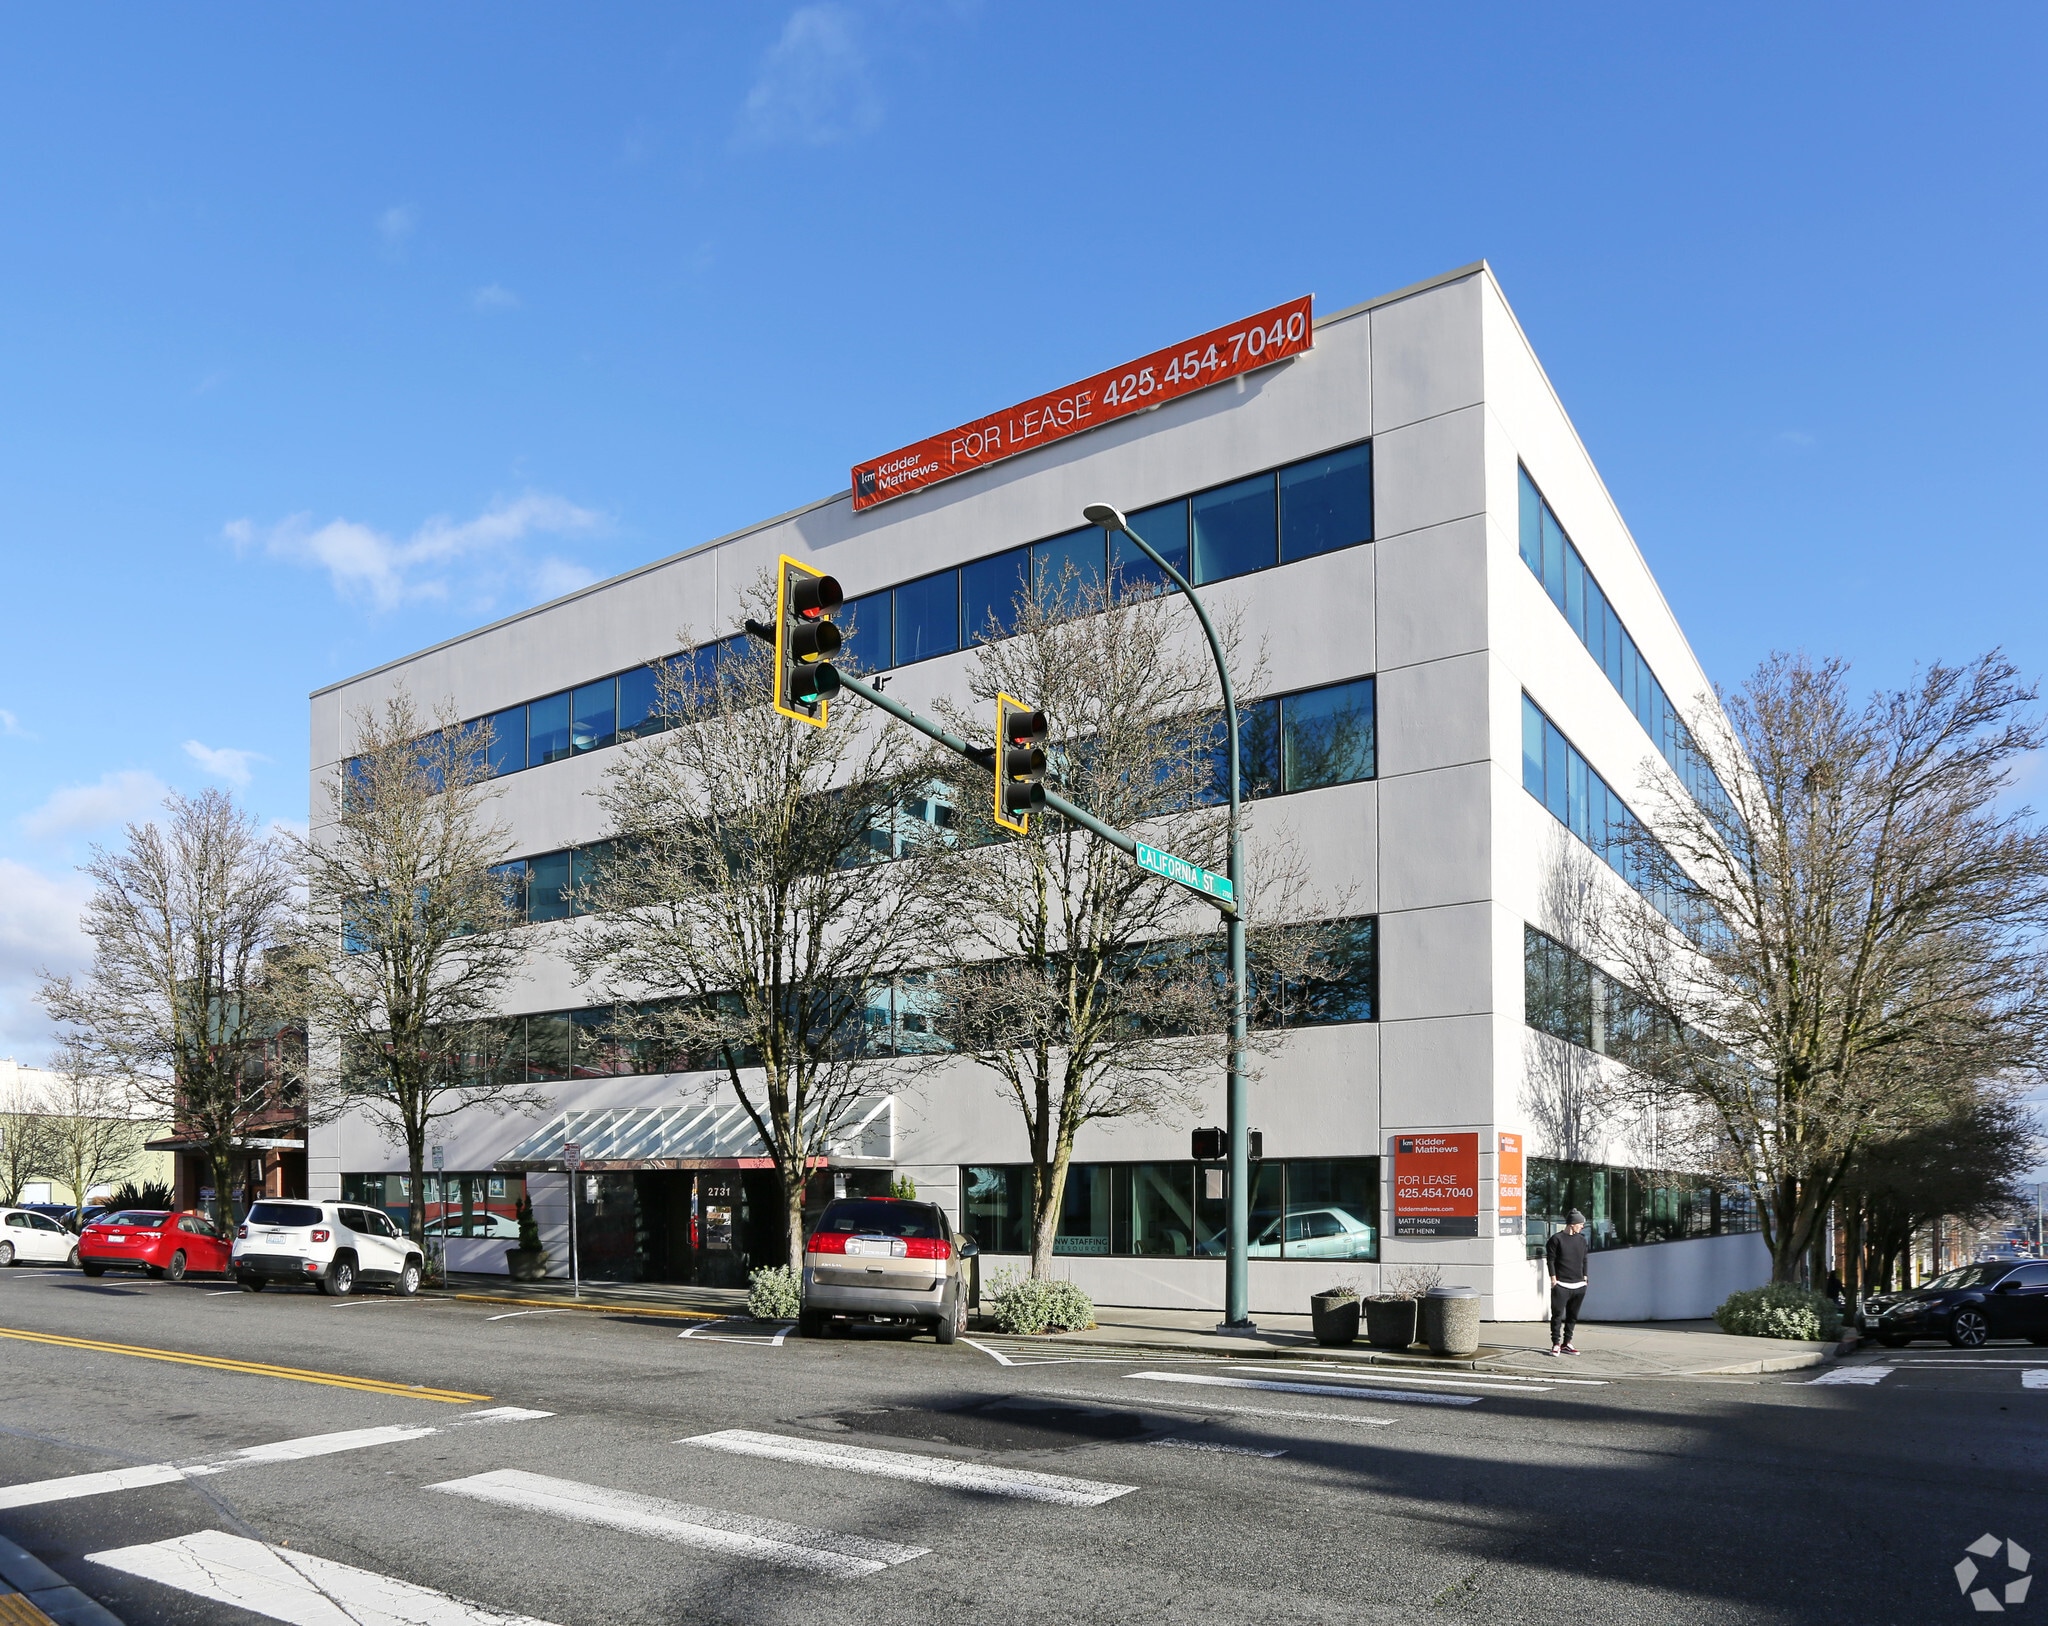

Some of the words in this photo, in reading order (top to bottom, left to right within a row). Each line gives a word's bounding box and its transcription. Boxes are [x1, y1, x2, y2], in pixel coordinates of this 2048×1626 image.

[951, 426, 1001, 465] FOR
[1009, 391, 1092, 443] LEASE
[1103, 312, 1306, 407] 425.454.7040
[878, 452, 922, 477] Kidder
[879, 461, 939, 492] Mathews
[1138, 846, 1199, 886] CALIFORNIA
[1203, 873, 1215, 893] ST
[1415, 1138, 1446, 1146] Kidder
[1415, 1146, 1458, 1154] Mathews
[1398, 1176, 1420, 1185] FOR
[1422, 1175, 1457, 1185] LEASE
[708, 1187, 731, 1197] 2731
[1398, 1188, 1473, 1198] 425.454.7040
